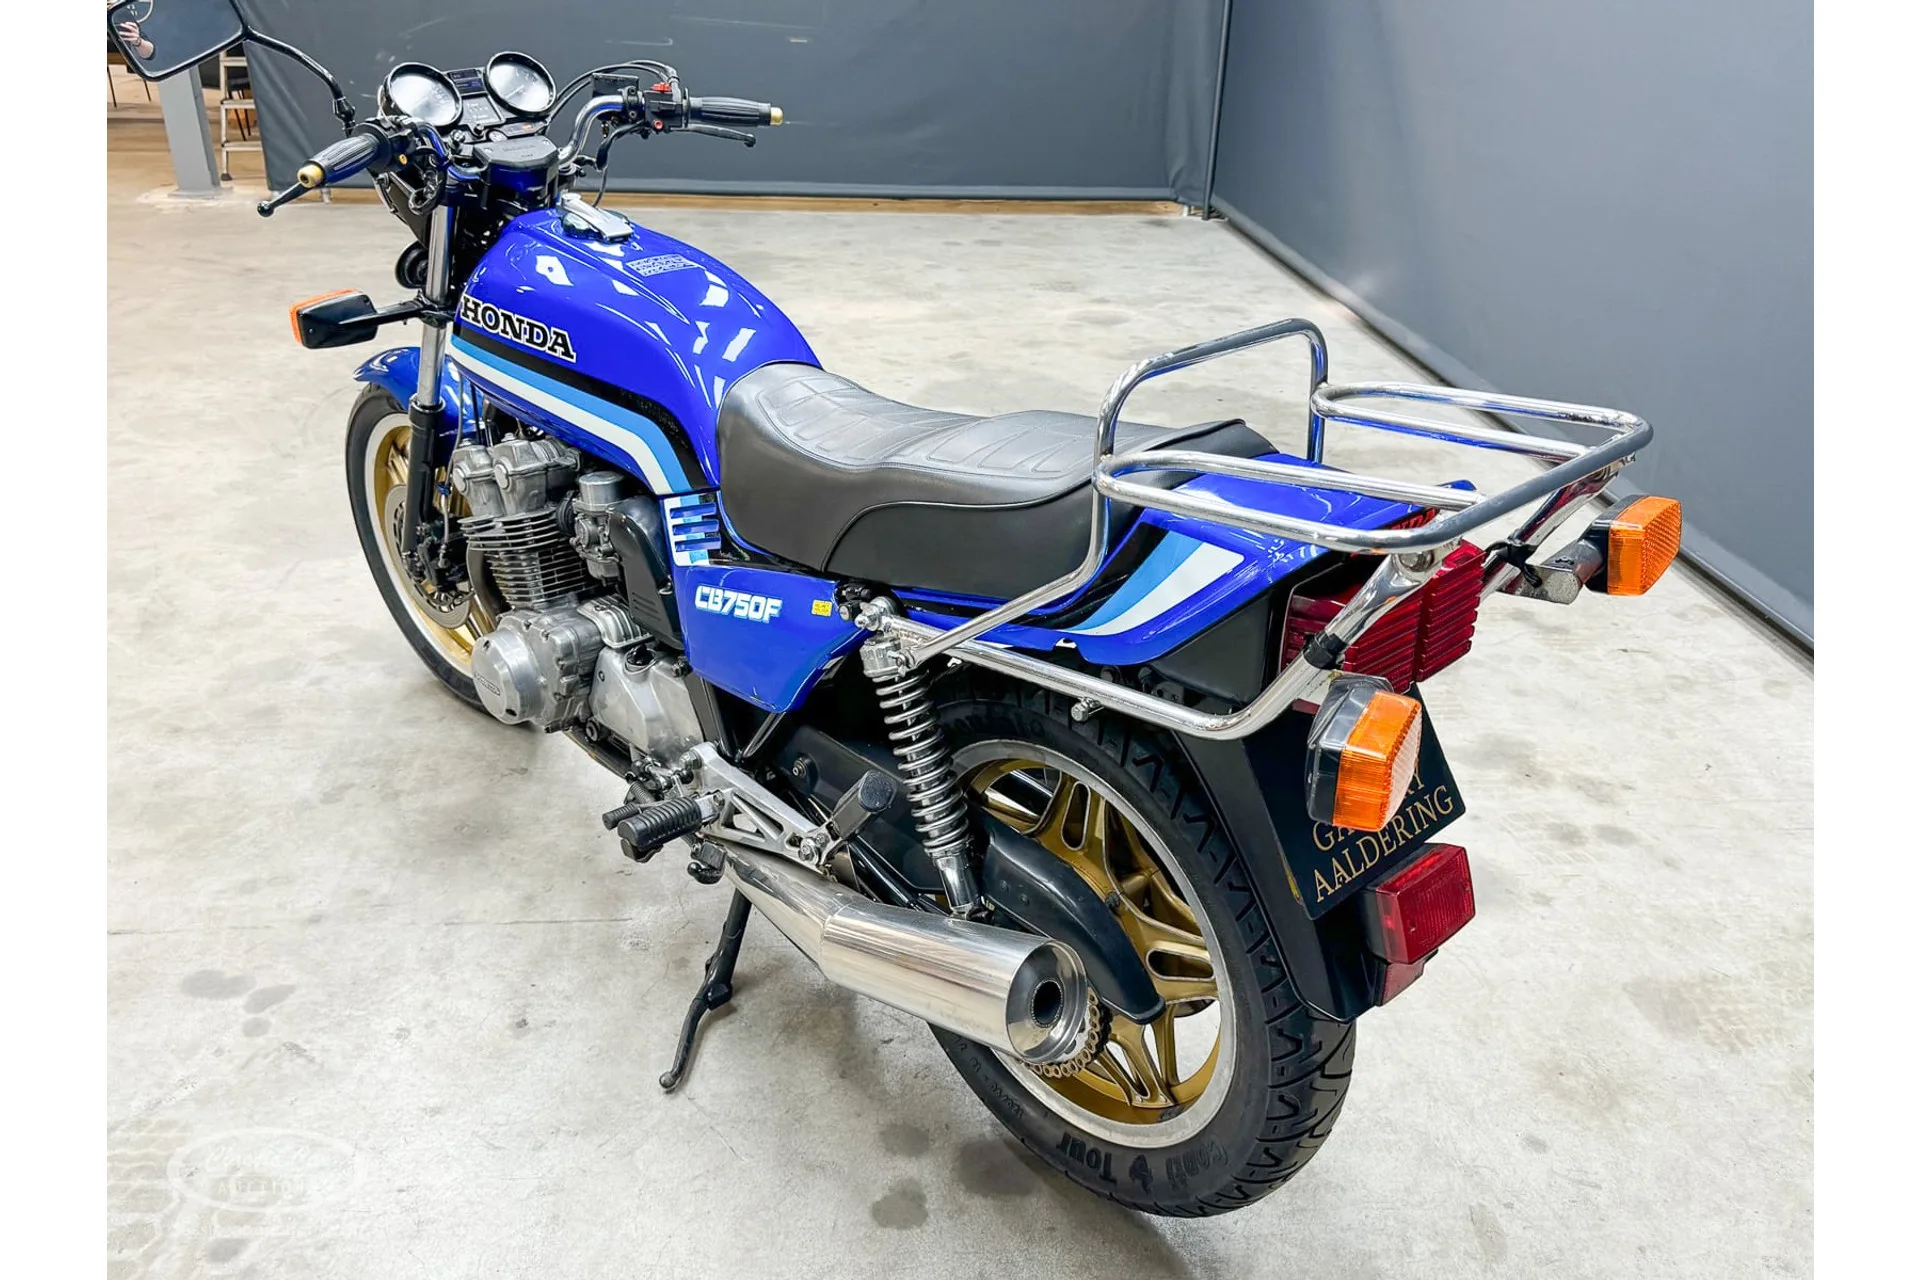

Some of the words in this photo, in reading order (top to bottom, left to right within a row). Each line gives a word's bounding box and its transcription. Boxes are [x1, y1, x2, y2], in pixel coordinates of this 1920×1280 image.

[461, 294, 576, 362] HONDA
[695, 585, 782, 623] CB750F
[1313, 785, 1454, 903] AALDERING
[1056, 1131, 1117, 1185] Tour
